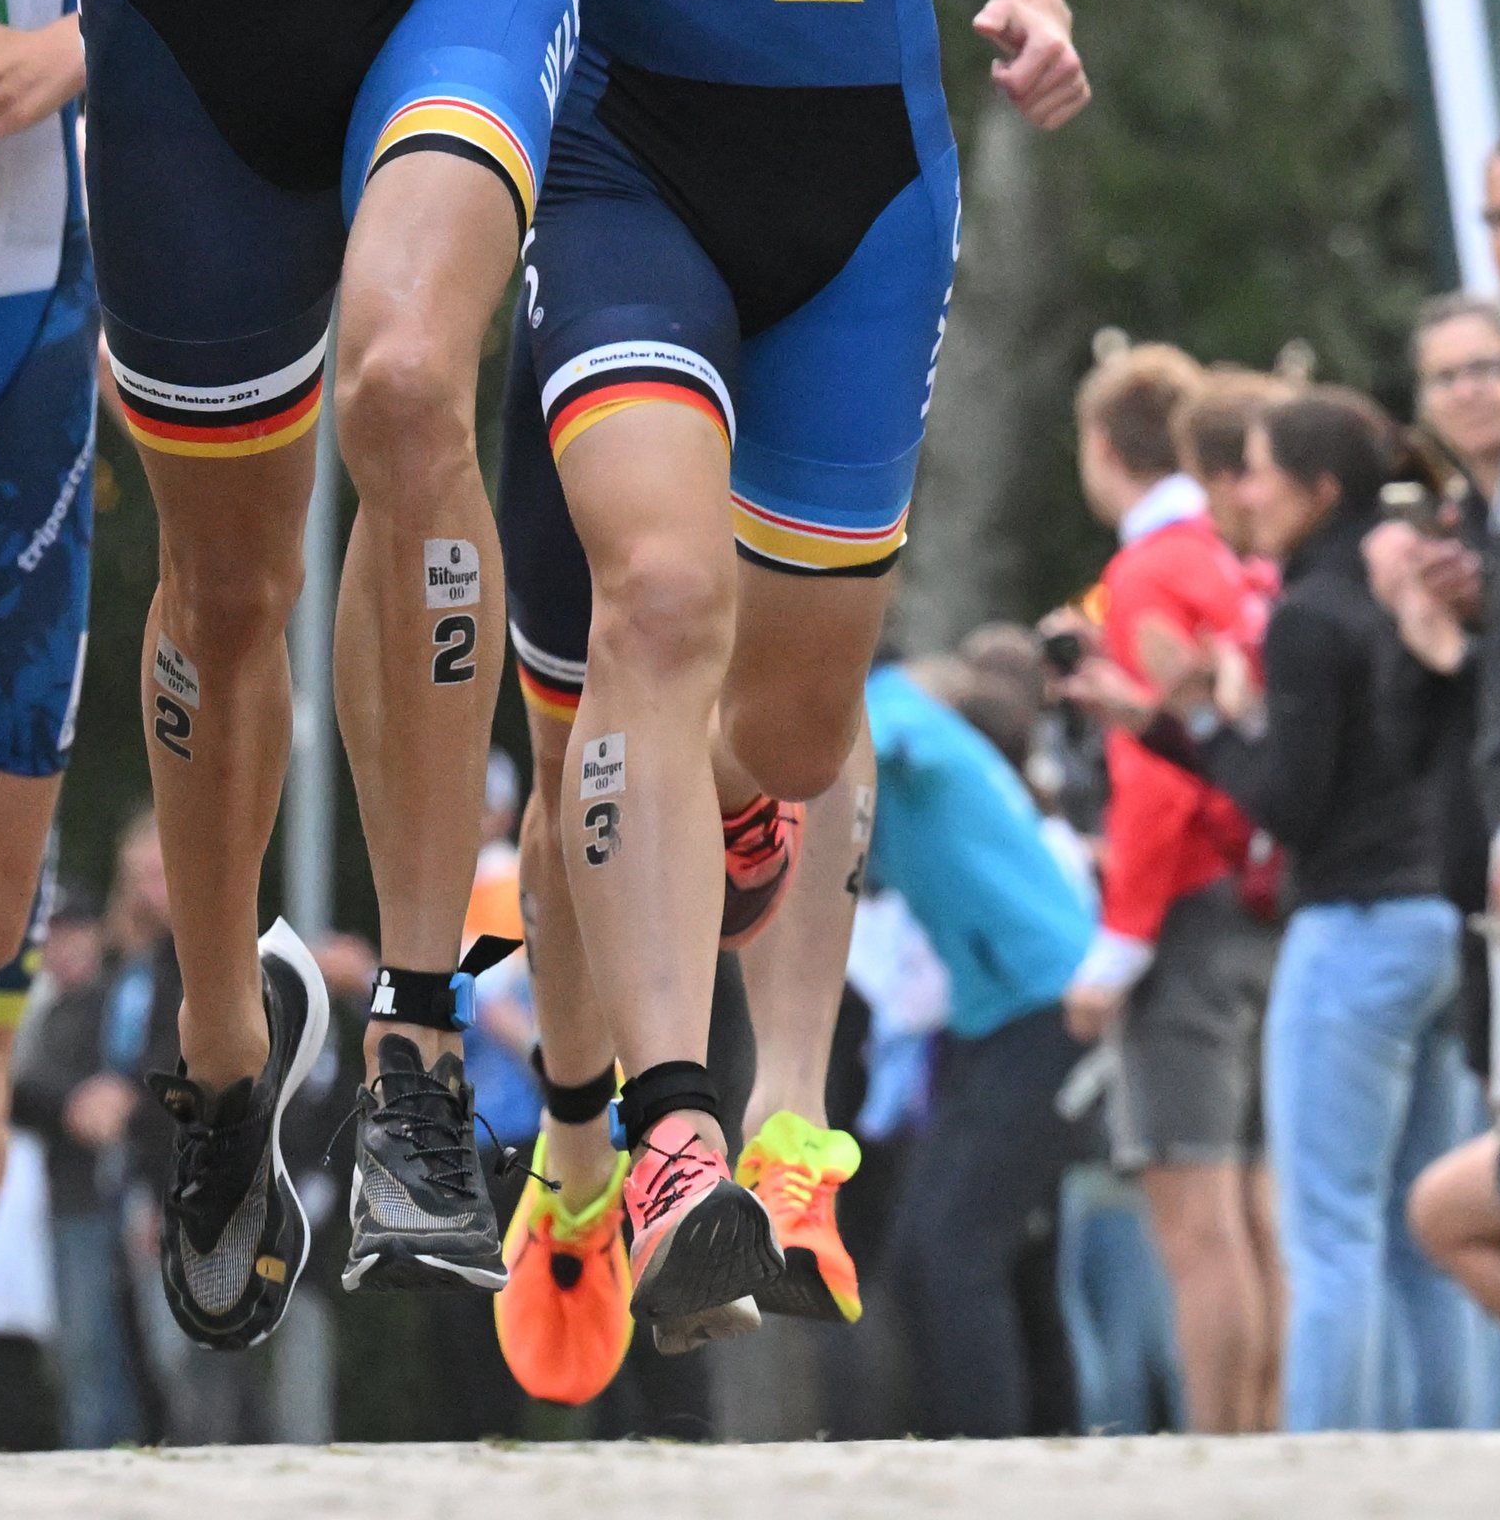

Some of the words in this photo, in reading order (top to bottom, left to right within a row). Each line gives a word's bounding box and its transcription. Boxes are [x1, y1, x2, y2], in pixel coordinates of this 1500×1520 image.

[589, 350, 651, 368] Deutscher
[653, 351, 697, 368] Meister
[122, 373, 172, 401] Deutscher
[174, 394, 226, 405] Meister
[227, 388, 260, 404] 2021
[428, 566, 478, 587] Bitburger
[433, 615, 476, 684] 2
[156, 649, 198, 694] Bitburger
[155, 694, 192, 761] 2
[583, 761, 623, 780] Bitburger
[585, 802, 620, 866] 3
